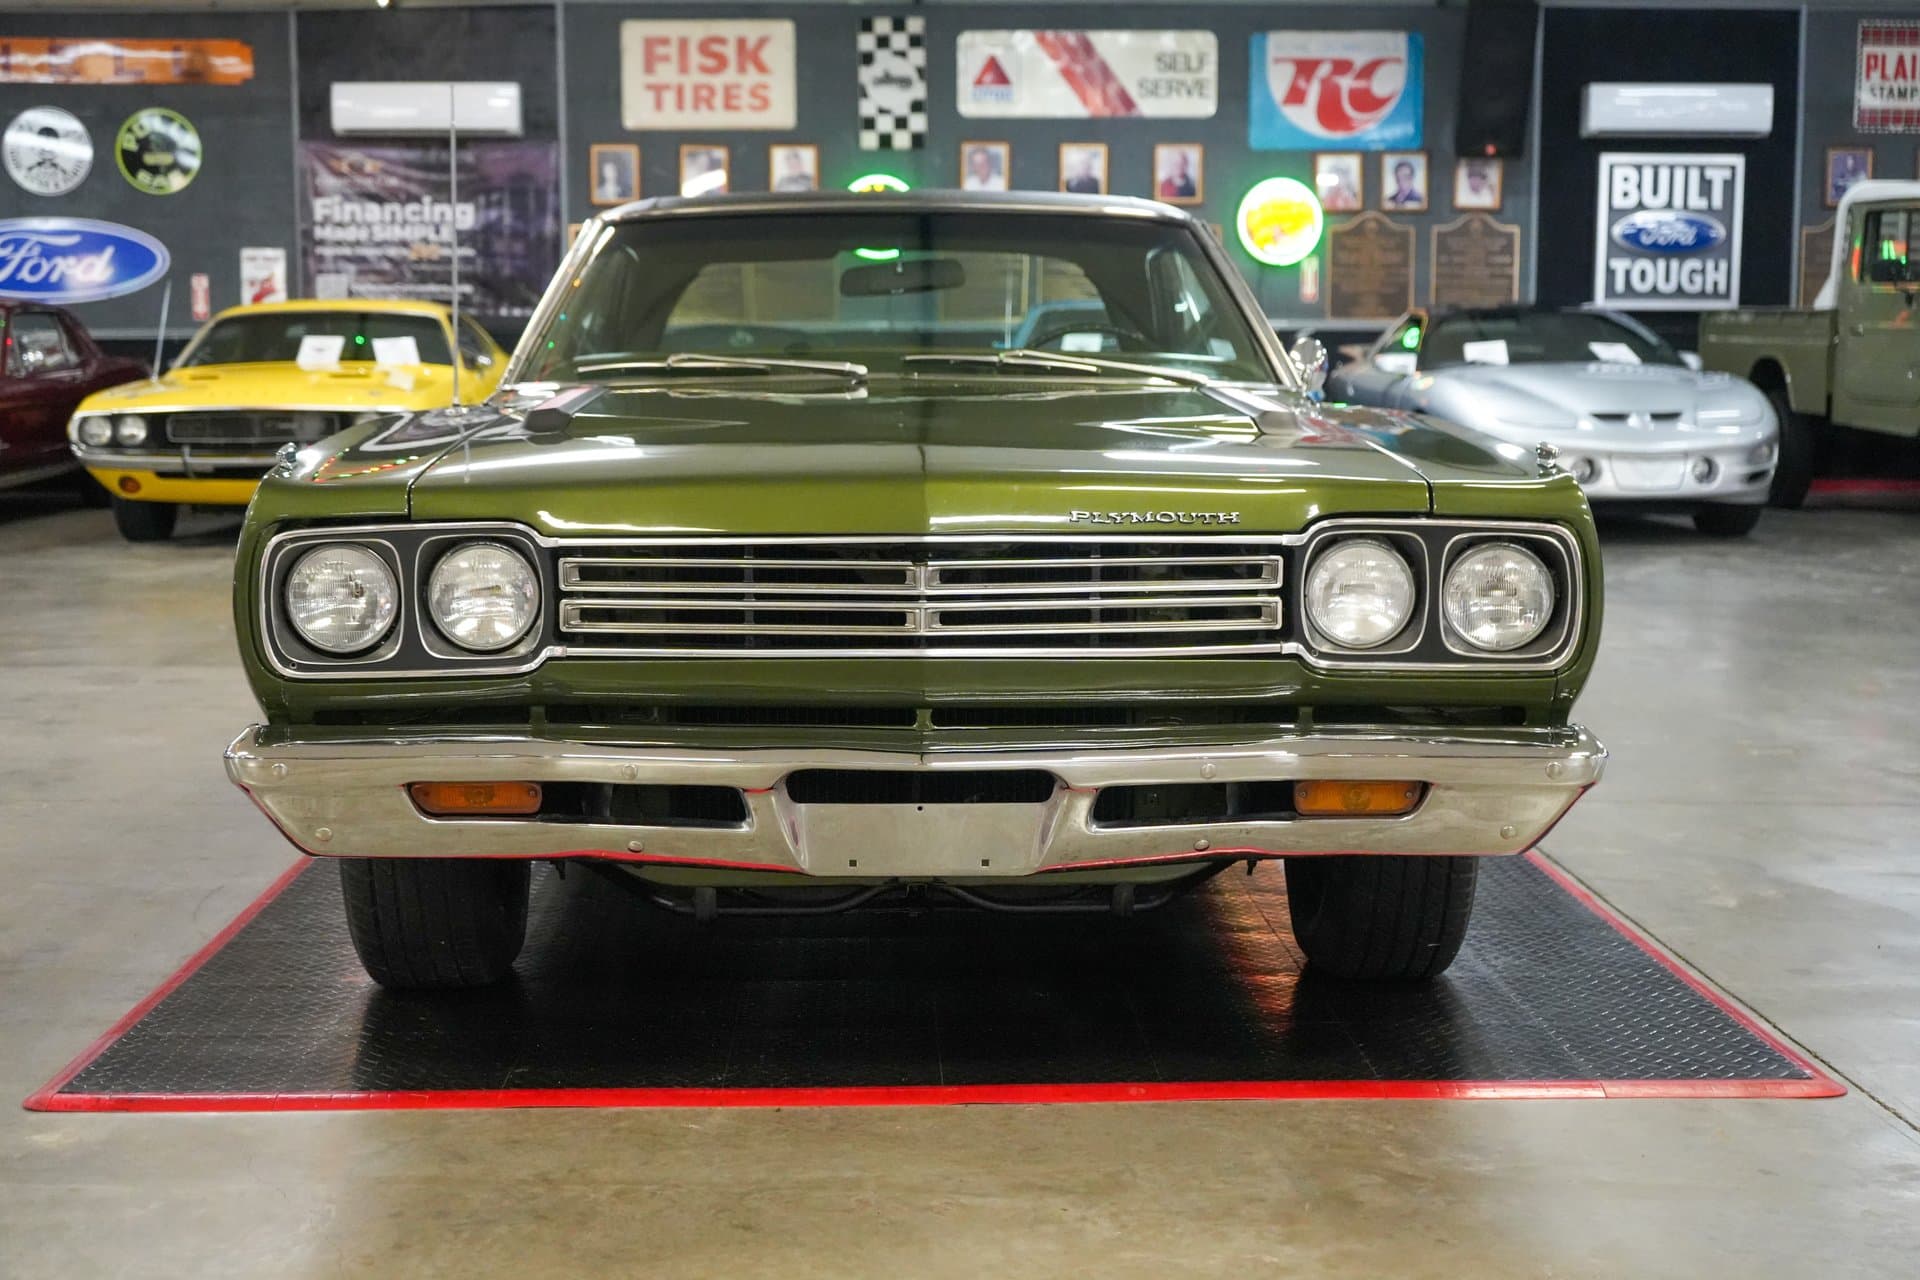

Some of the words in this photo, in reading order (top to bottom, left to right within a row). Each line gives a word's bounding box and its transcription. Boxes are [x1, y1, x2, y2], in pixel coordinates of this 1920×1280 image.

[643, 35, 772, 75] FISK
[1156, 52, 1209, 73] SELF
[645, 83, 772, 112] TIRES
[1137, 78, 1211, 98] SERVE
[1273, 57, 1404, 135] RC
[1611, 164, 1733, 211] BUILT
[313, 195, 476, 230] Financing
[1639, 220, 1698, 246] Ford
[0, 233, 116, 284] Ford
[1608, 257, 1729, 295] TOUGH
[1069, 510, 1241, 525] PLYMOUTH
